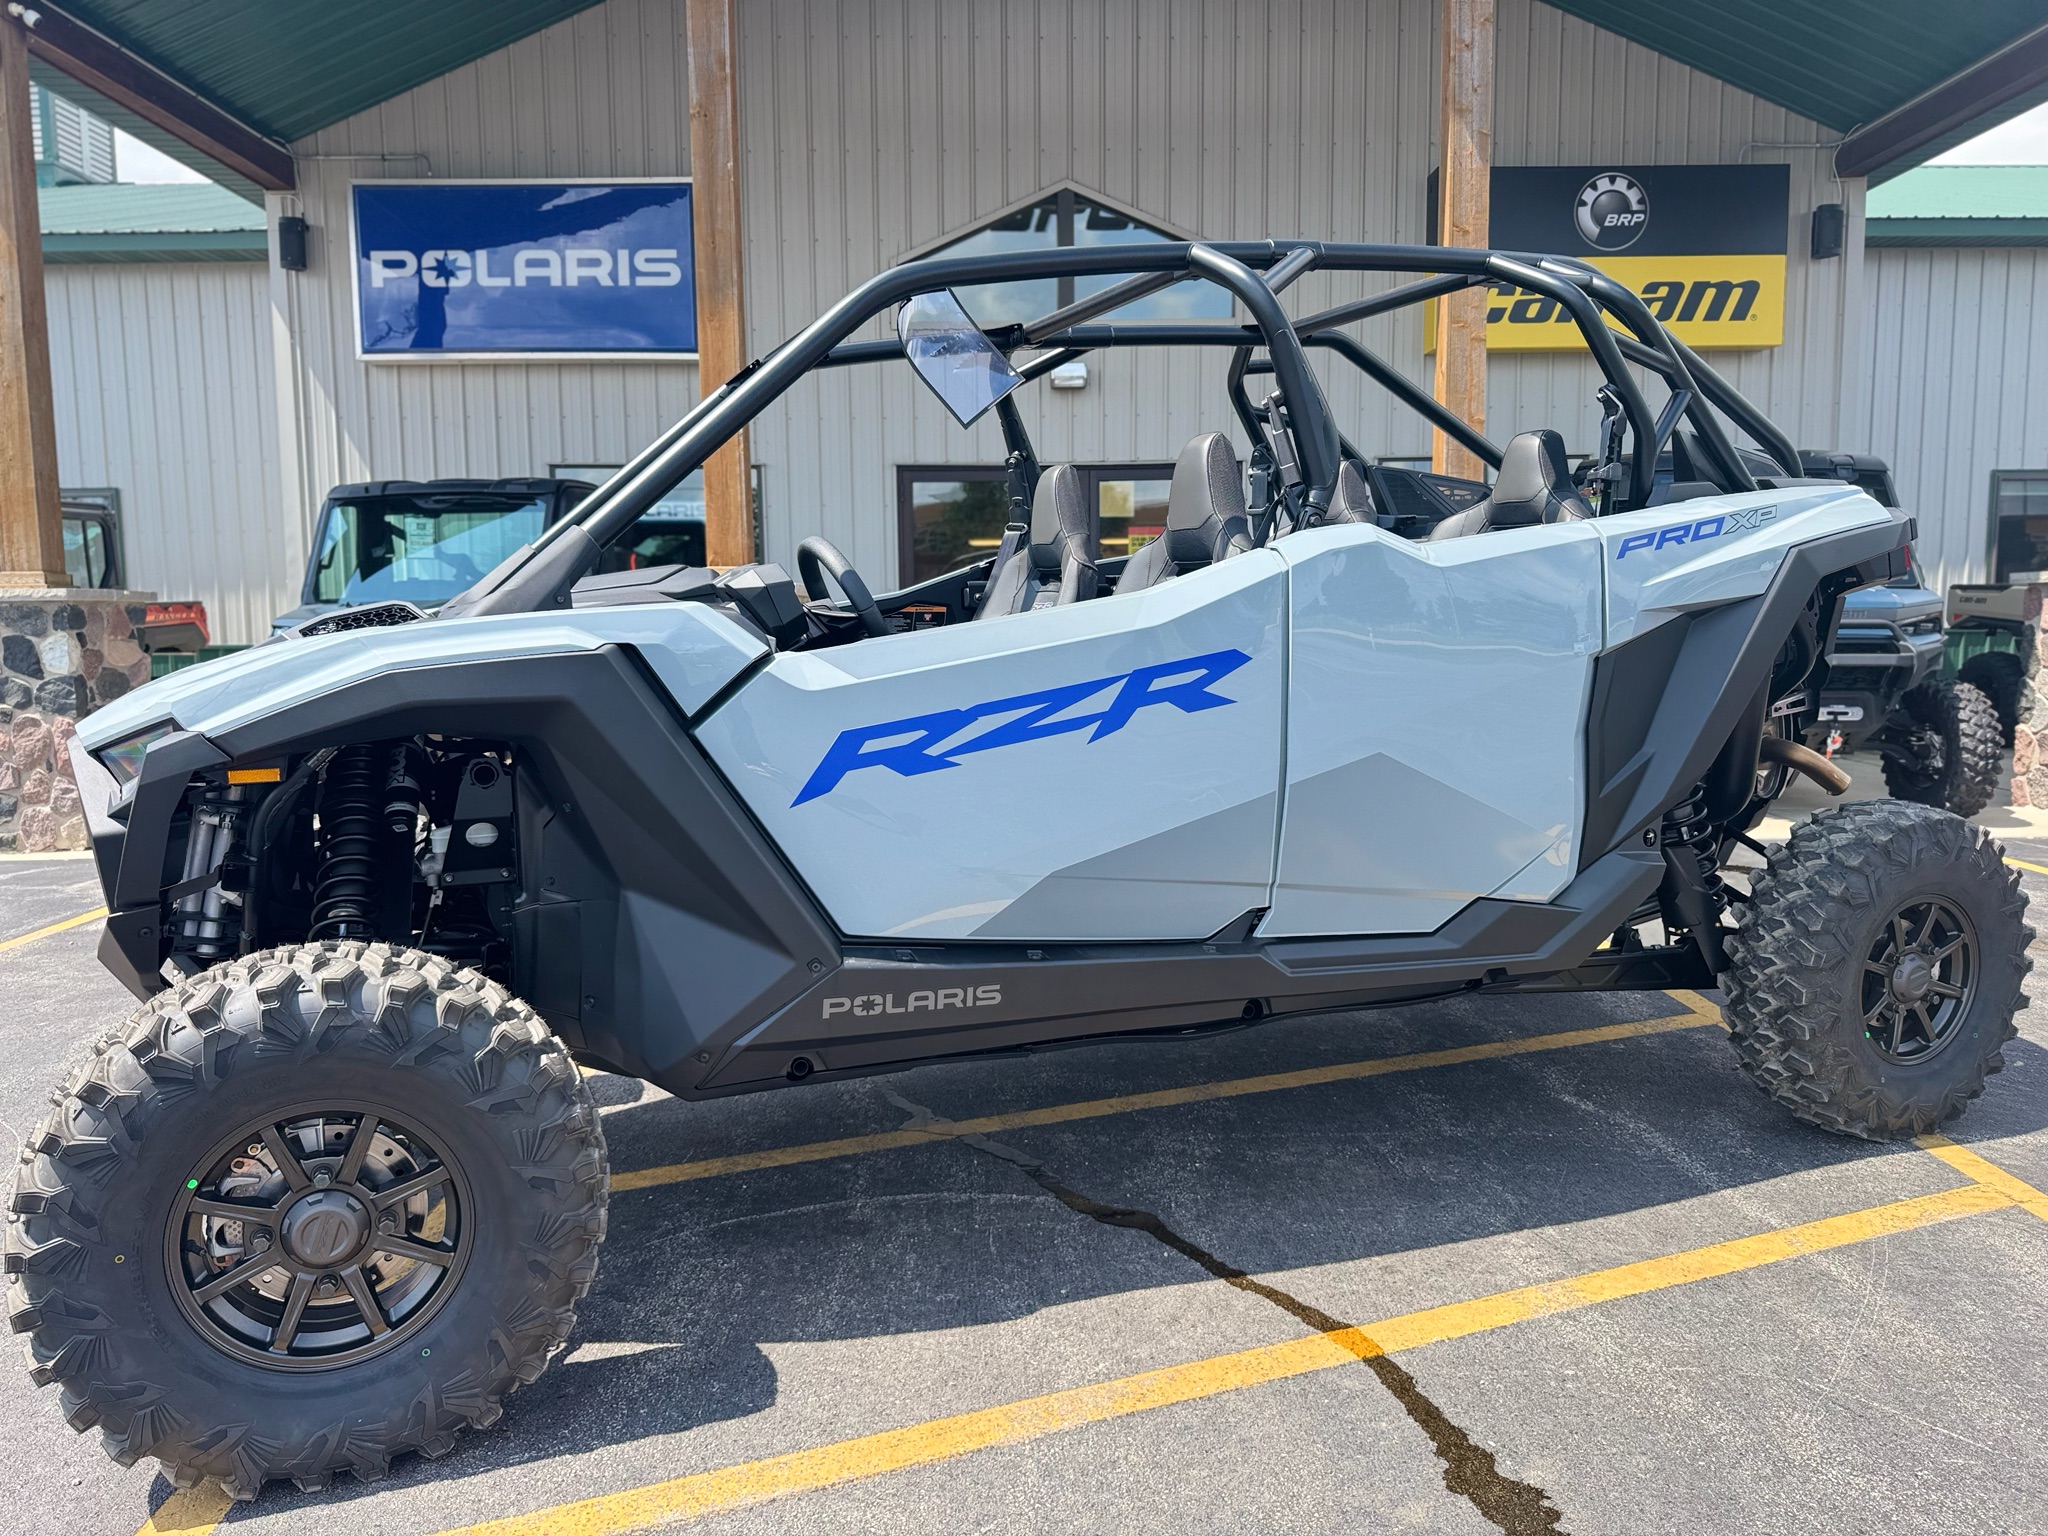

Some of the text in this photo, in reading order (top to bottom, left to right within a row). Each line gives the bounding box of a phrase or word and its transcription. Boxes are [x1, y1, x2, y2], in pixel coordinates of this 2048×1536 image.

[1603, 213, 1645, 227] BRP
[370, 249, 681, 287] POLARIS
[1616, 504, 1778, 560] PRO XP
[789, 648, 1253, 809] RZR
[822, 984, 1002, 1019] POLARIS
